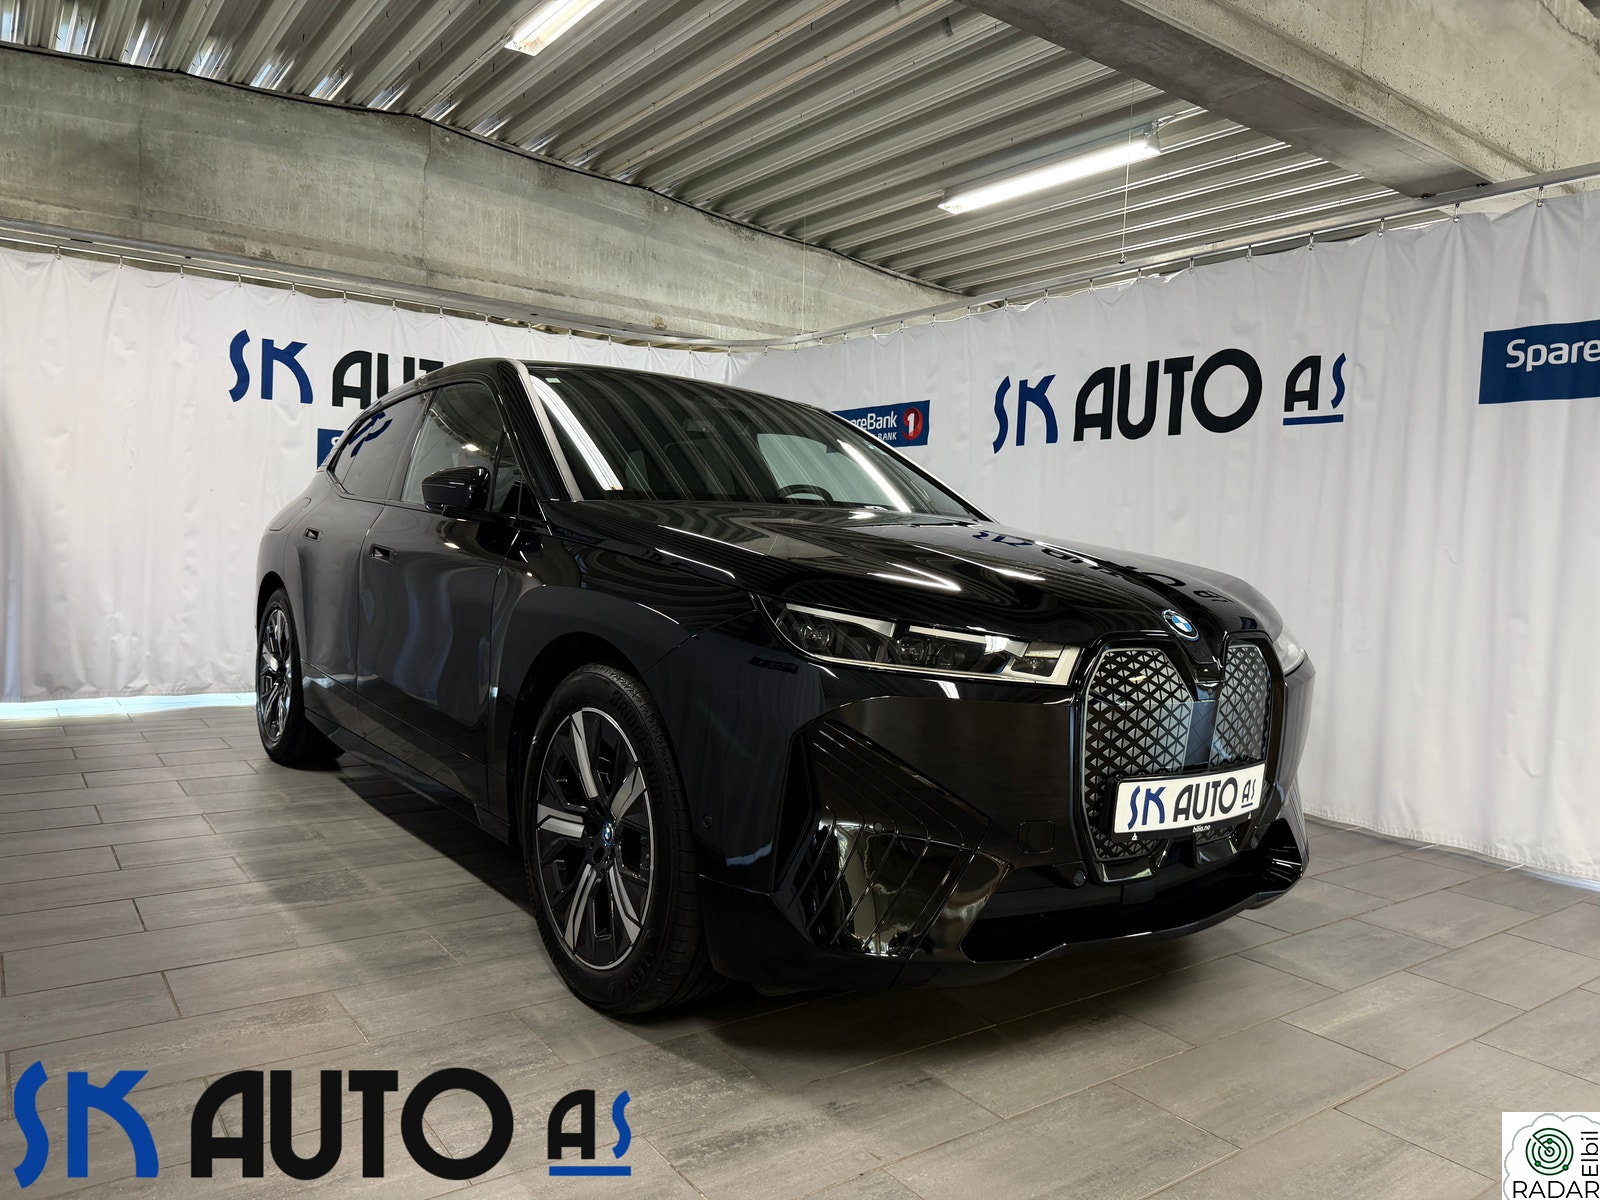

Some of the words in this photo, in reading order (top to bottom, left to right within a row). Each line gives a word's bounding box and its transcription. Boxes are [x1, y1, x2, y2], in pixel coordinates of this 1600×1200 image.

[229, 329, 313, 404] SK
[1505, 338, 1600, 372] Spare
[992, 374, 1058, 454] SK
[1073, 348, 1262, 442] AUTO
[1284, 352, 1347, 412] AS
[609, 689, 665, 812] BRIDGESTONE
[1127, 785, 1166, 830] SK
[1173, 777, 1238, 822] AUTO
[1241, 779, 1257, 803] AS
